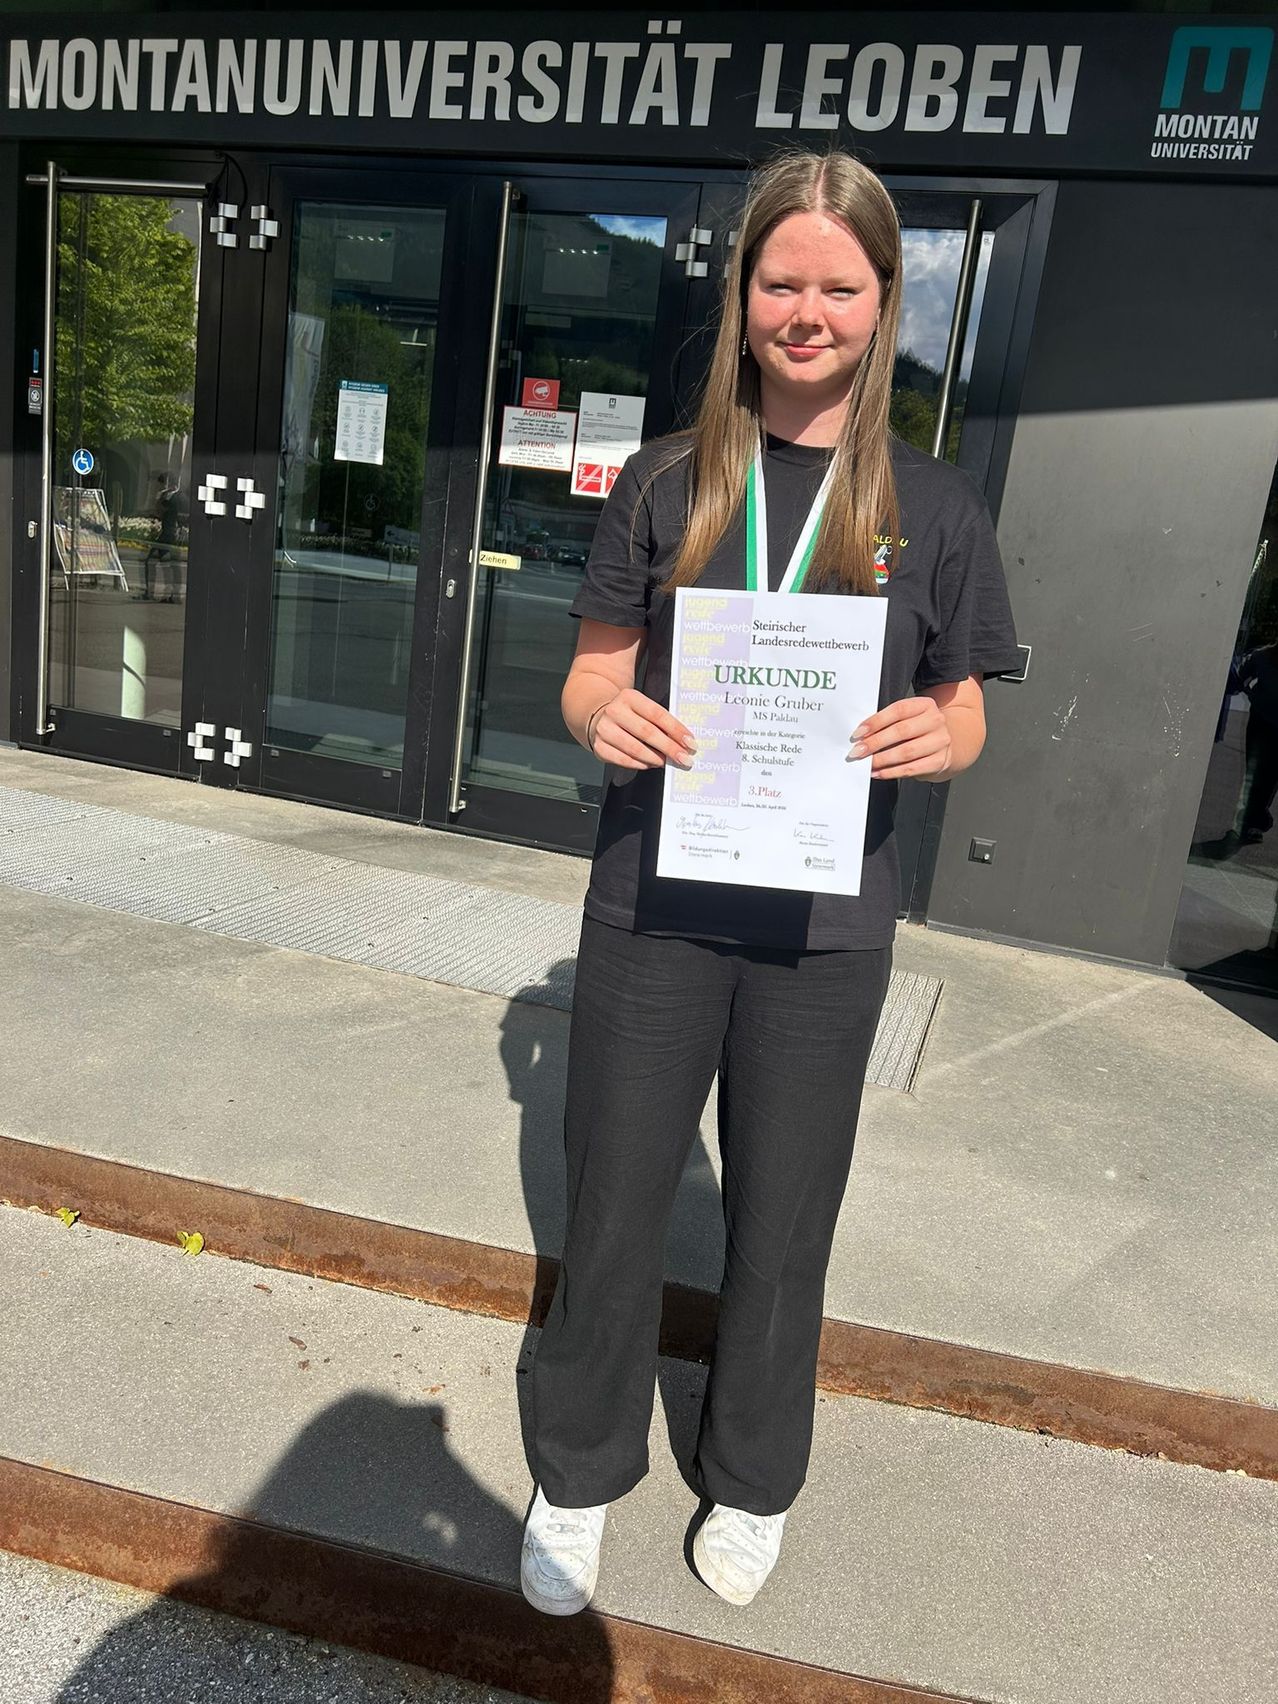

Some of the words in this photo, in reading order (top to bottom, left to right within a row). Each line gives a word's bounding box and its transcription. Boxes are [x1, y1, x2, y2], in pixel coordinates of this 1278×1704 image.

[9, 20, 731, 126] MONTANUNIVERSITÄT
[755, 42, 1082, 135] LEOBEN
[1154, 113, 1259, 140] MONTAN
[1150, 141, 1253, 160] UNIVERSITÄT
[523, 409, 557, 420] ACHTUNG
[518, 439, 556, 449] ATTENTION
[480, 554, 507, 565] Ziehen
[683, 620, 751, 633] wettbewerb
[752, 620, 807, 633] Steirischer
[752, 635, 870, 651] Landesredewettbewerb
[714, 664, 837, 690] URKUNDE
[725, 692, 770, 707] Leonie
[774, 695, 825, 711] Gruber
[753, 711, 768, 721] MS
[770, 713, 799, 723] Paldau
[735, 741, 778, 752] Klassische
[780, 743, 802, 753] Rede
[742, 754, 750, 763] 8.
[752, 755, 795, 766] Schulstufe
[748, 785, 782, 799] 3.Platz
